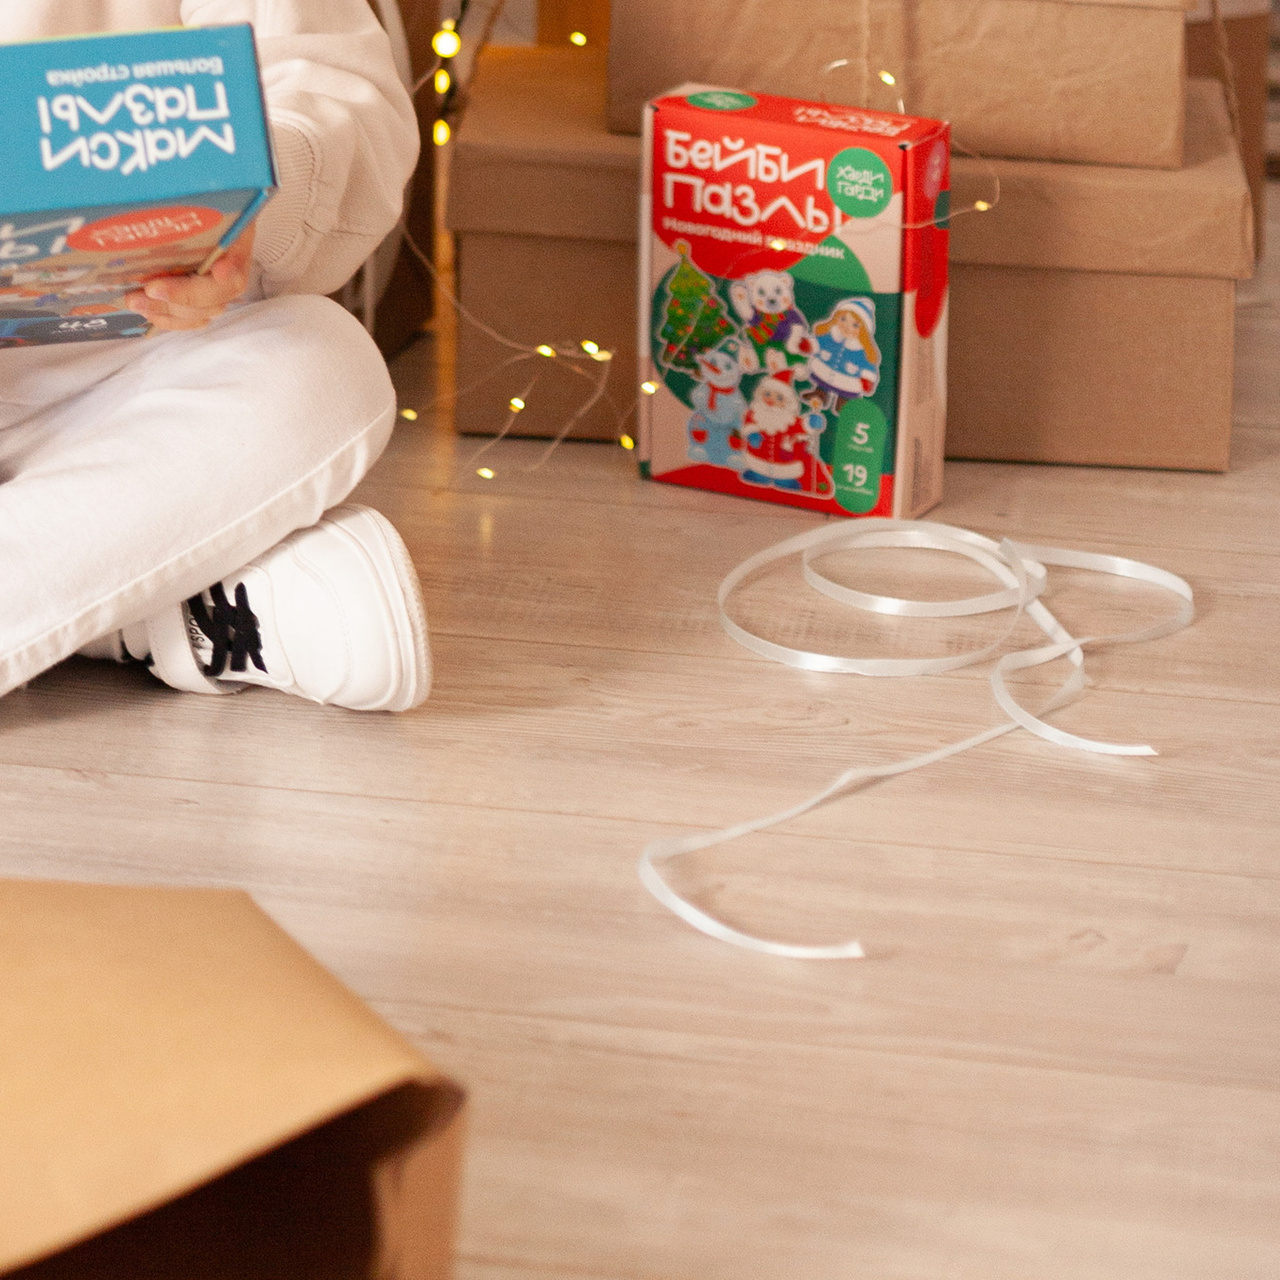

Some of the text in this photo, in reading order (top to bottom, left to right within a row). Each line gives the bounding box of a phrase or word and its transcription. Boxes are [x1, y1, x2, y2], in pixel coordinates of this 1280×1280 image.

[45, 55, 224, 87] Большая стройка
[765, 236, 846, 260] паздник
[852, 422, 870, 445] 5
[843, 464, 868, 487] 19
